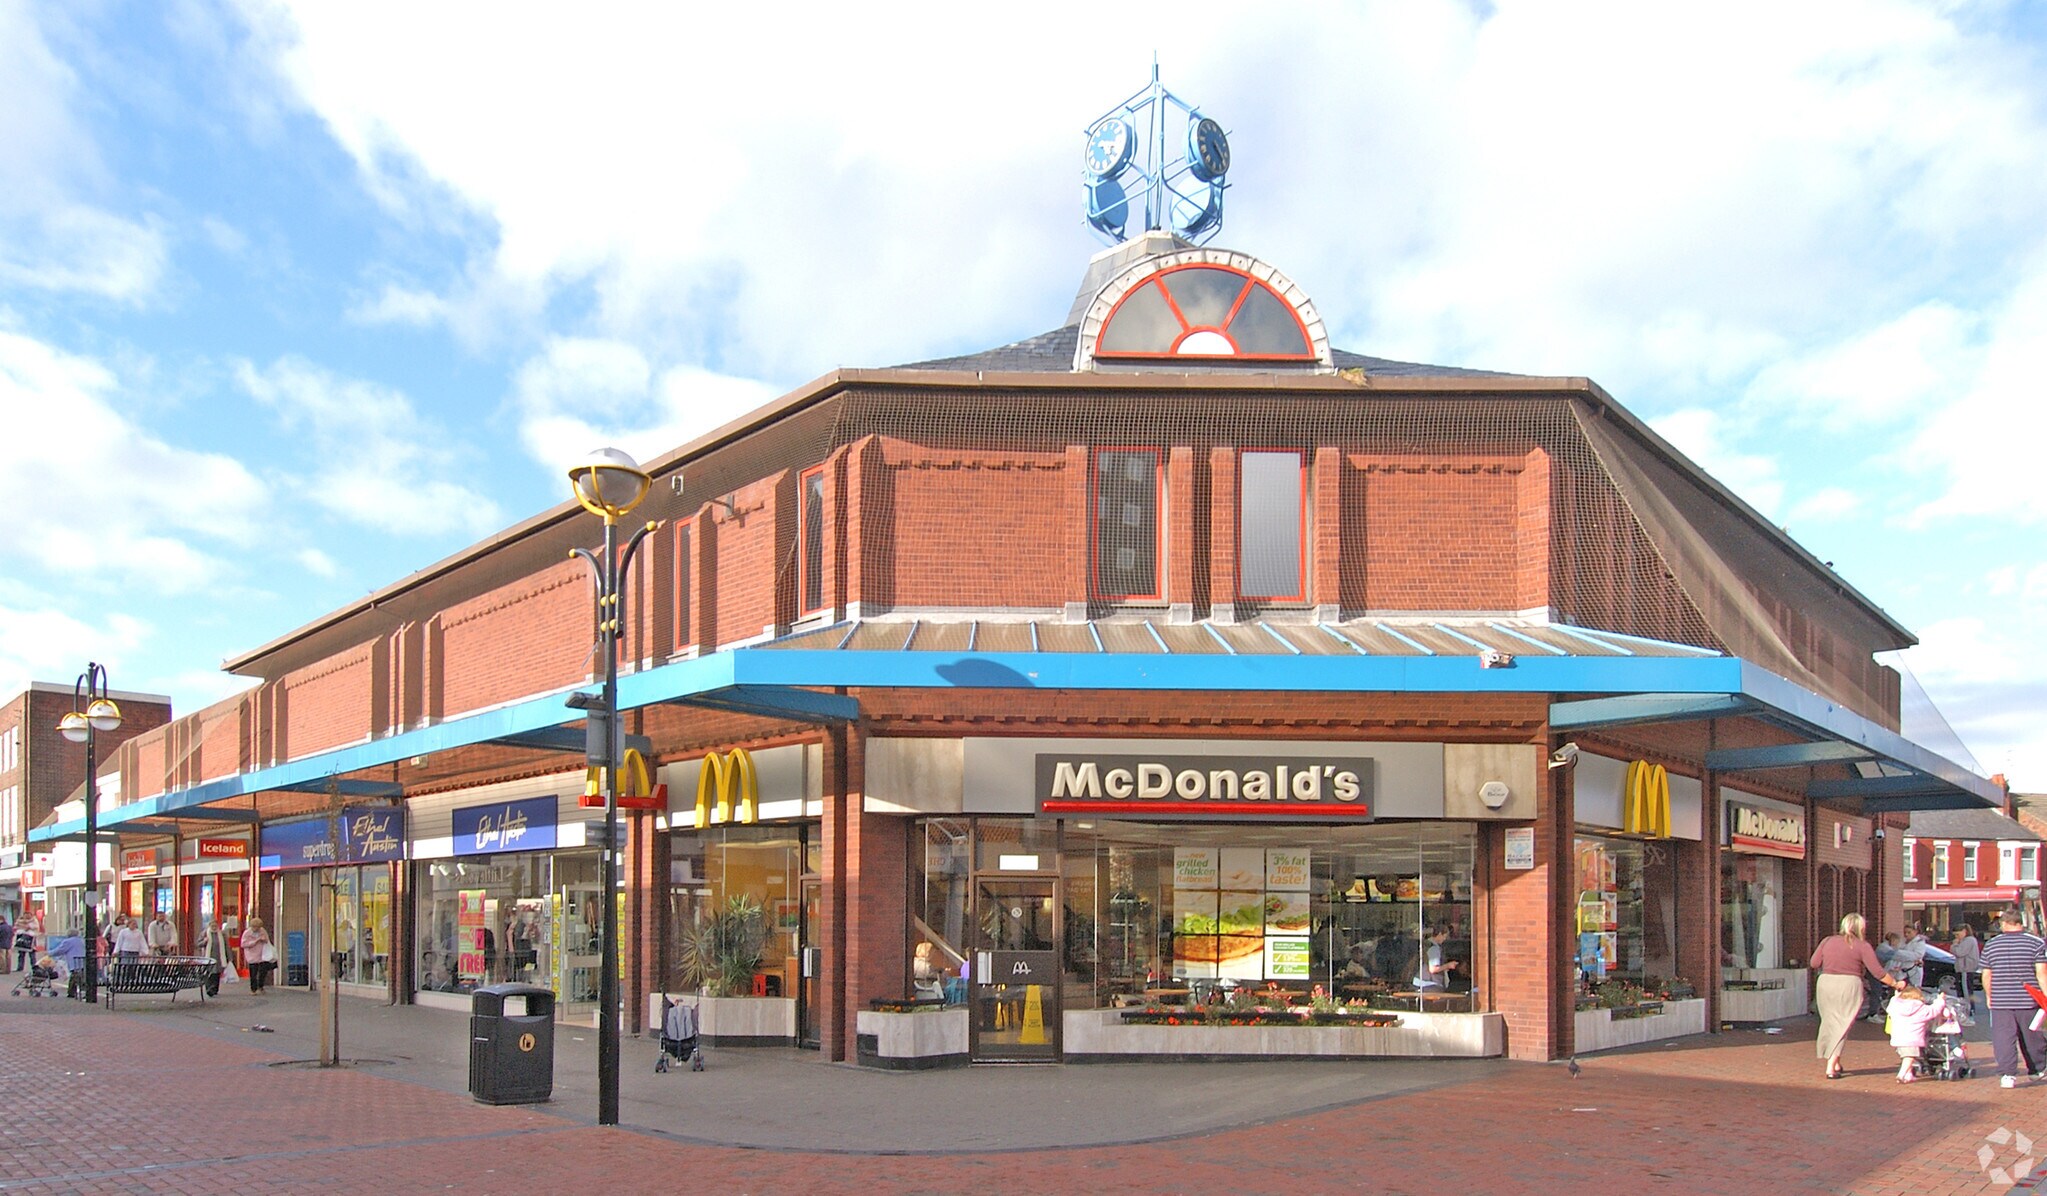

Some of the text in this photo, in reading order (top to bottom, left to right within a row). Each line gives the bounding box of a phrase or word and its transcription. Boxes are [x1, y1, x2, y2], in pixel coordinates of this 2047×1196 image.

[1051, 762, 1360, 801] McDonald's
[203, 843, 244, 853] Iceland
[361, 831, 399, 857] Austin
[1176, 859, 1208, 868] grilled
[1179, 866, 1215, 875] chicken
[1270, 874, 1307, 885] taste!
